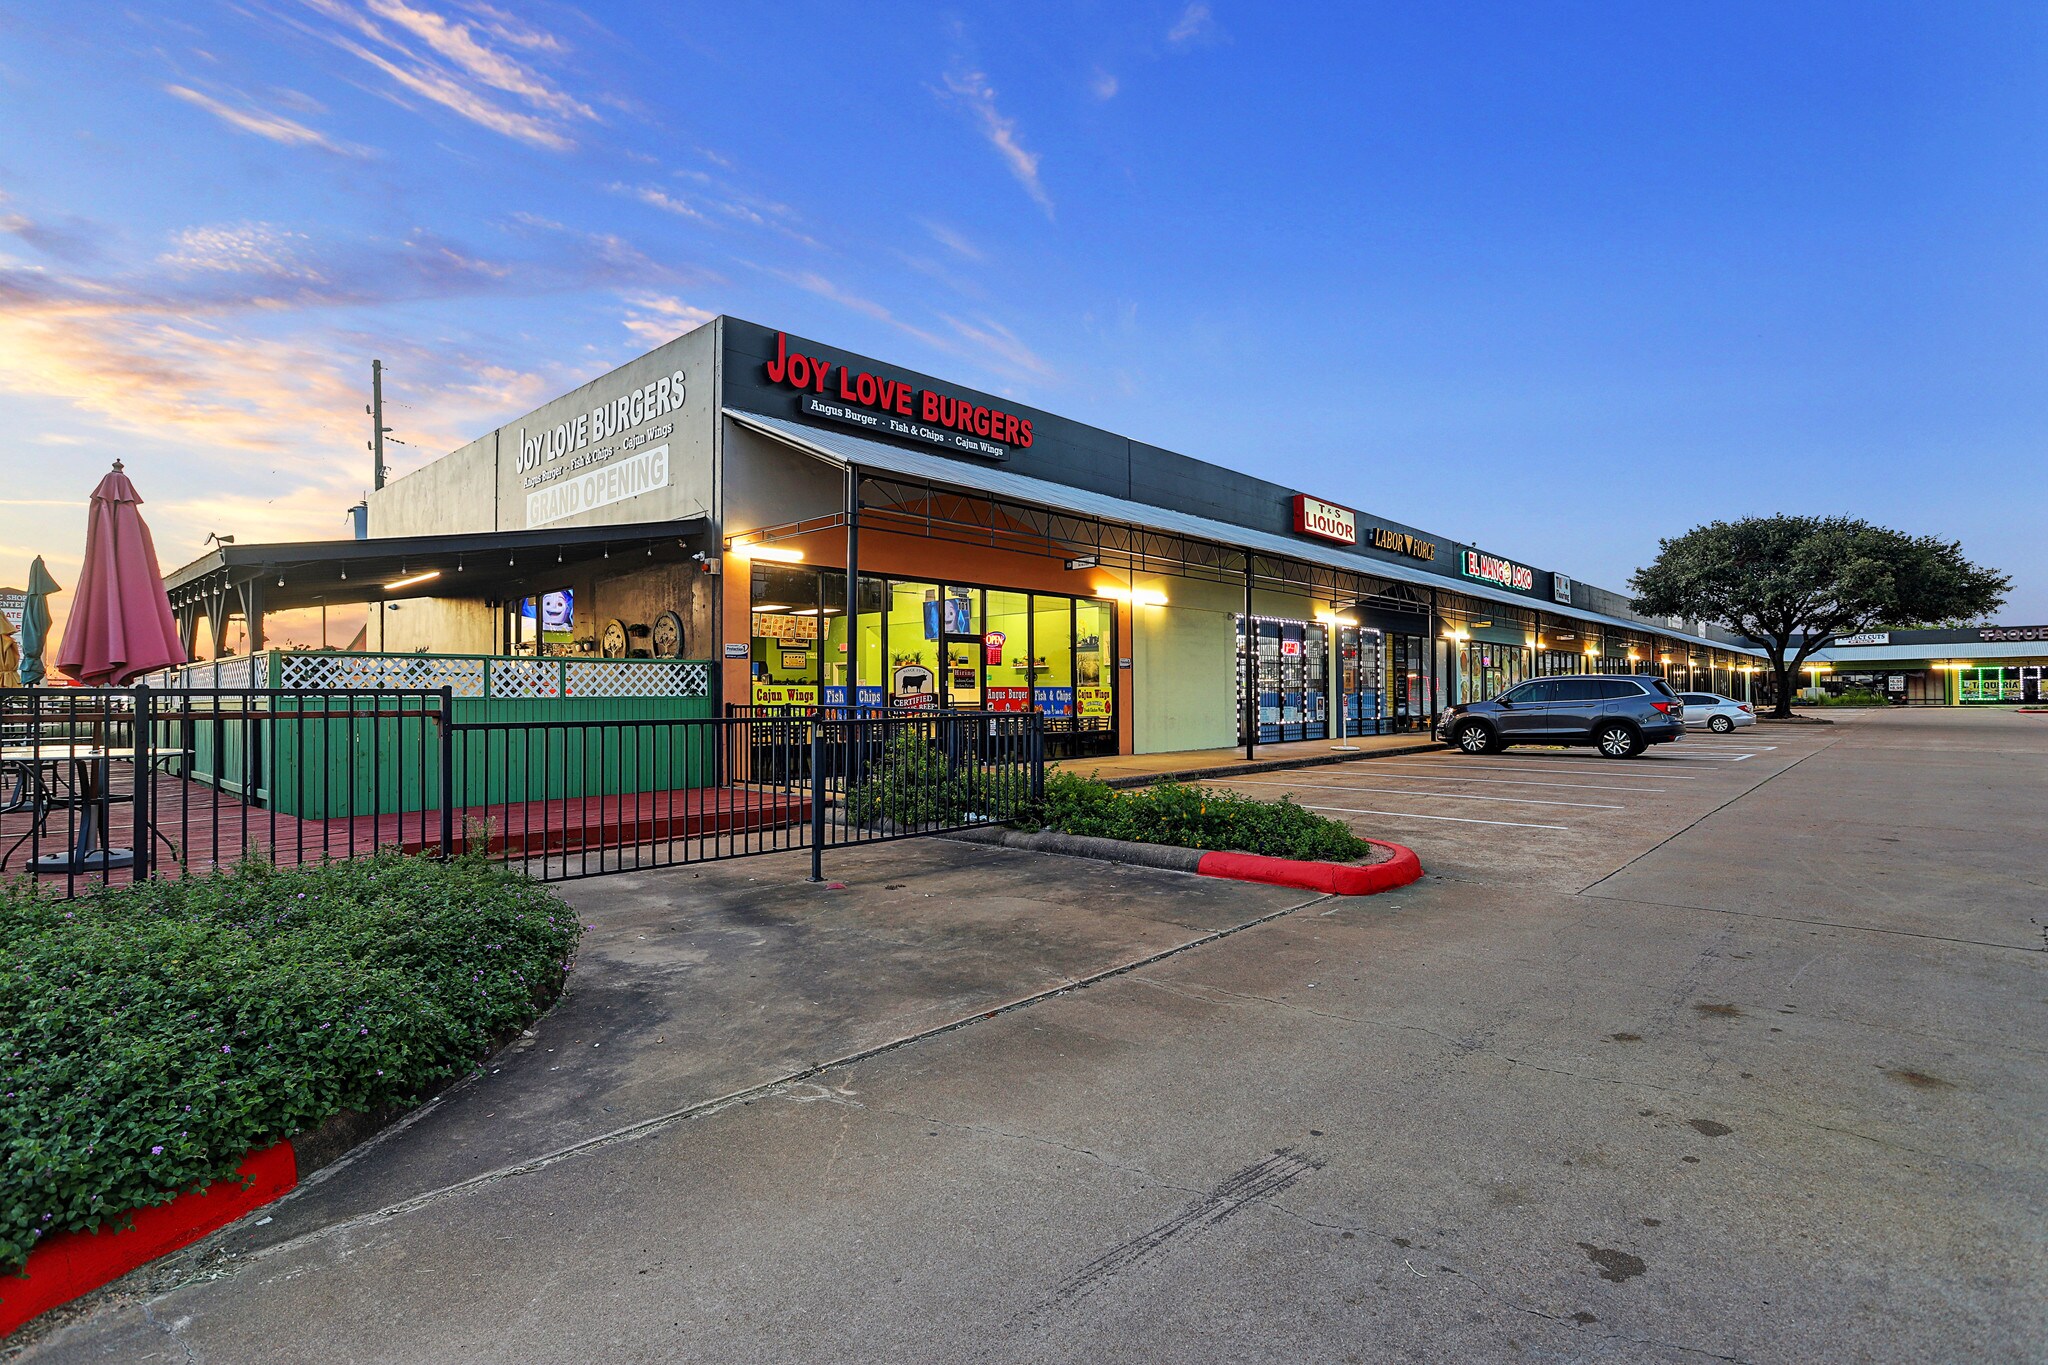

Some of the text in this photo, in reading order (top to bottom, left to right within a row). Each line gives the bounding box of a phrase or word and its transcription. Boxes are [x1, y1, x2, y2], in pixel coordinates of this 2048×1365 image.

[767, 331, 1034, 449] JOY LOVE BURGERS
[516, 370, 686, 475] JOY LOVE BURGERS
[810, 399, 1004, 457] Angus Burger Fish & Chips Cajun Wings
[523, 422, 673, 489] Angus Burger Fish & Chips Cajun Wings
[530, 451, 664, 524] GRAND OPENING
[1318, 503, 1326, 514] T
[1335, 509, 1341, 519] S
[1305, 511, 1354, 540] LIQUOR
[1375, 527, 1435, 561] LABOR FORCE
[1468, 551, 1480, 576] EL
[1512, 564, 1533, 590] LOKO
[986, 634, 1003, 646] OPEN
[954, 669, 975, 677] Hiring
[757, 688, 814, 703] Cajun Wings
[826, 690, 881, 705] Fish Chips
[893, 694, 933, 707] CERTIFIED
[988, 688, 1028, 702] Angus Burger
[1034, 690, 1072, 703] Fish & Chips
[1077, 689, 1110, 702] Cajun Wings
